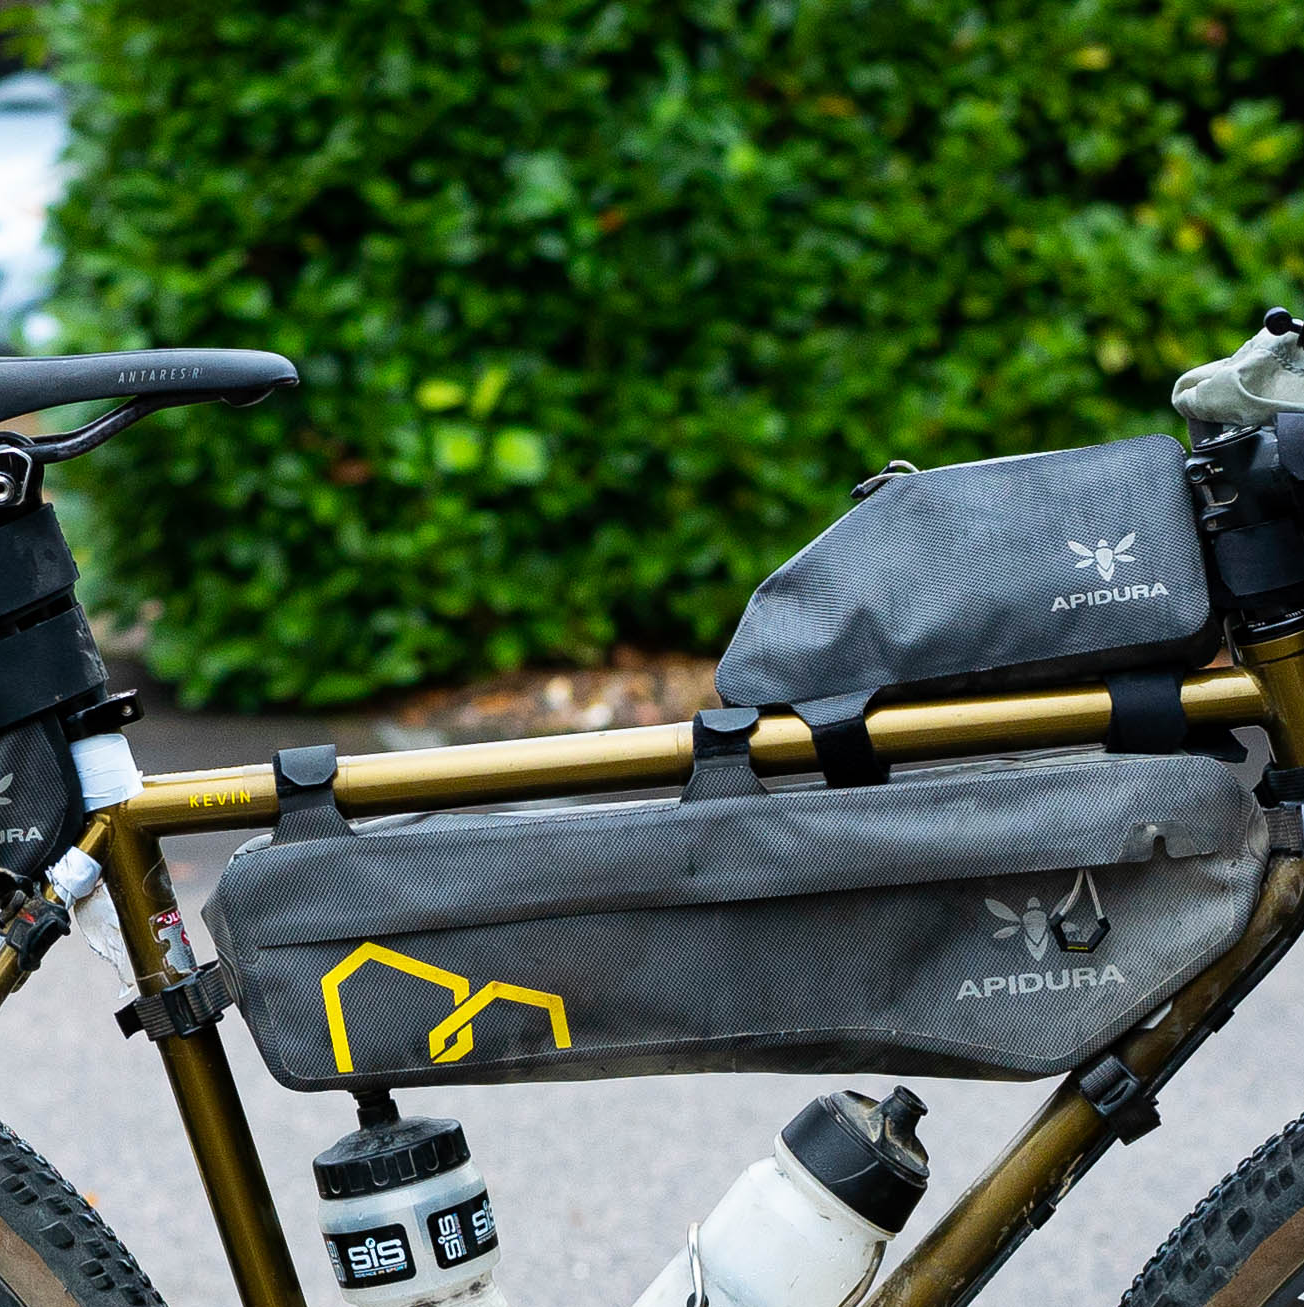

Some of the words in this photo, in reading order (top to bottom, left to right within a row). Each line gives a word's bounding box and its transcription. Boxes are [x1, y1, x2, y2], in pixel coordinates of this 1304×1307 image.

[1051, 582, 1170, 612] APIDURA
[189, 790, 251, 808] KEVIN
[956, 964, 1126, 1001] APIDURA
